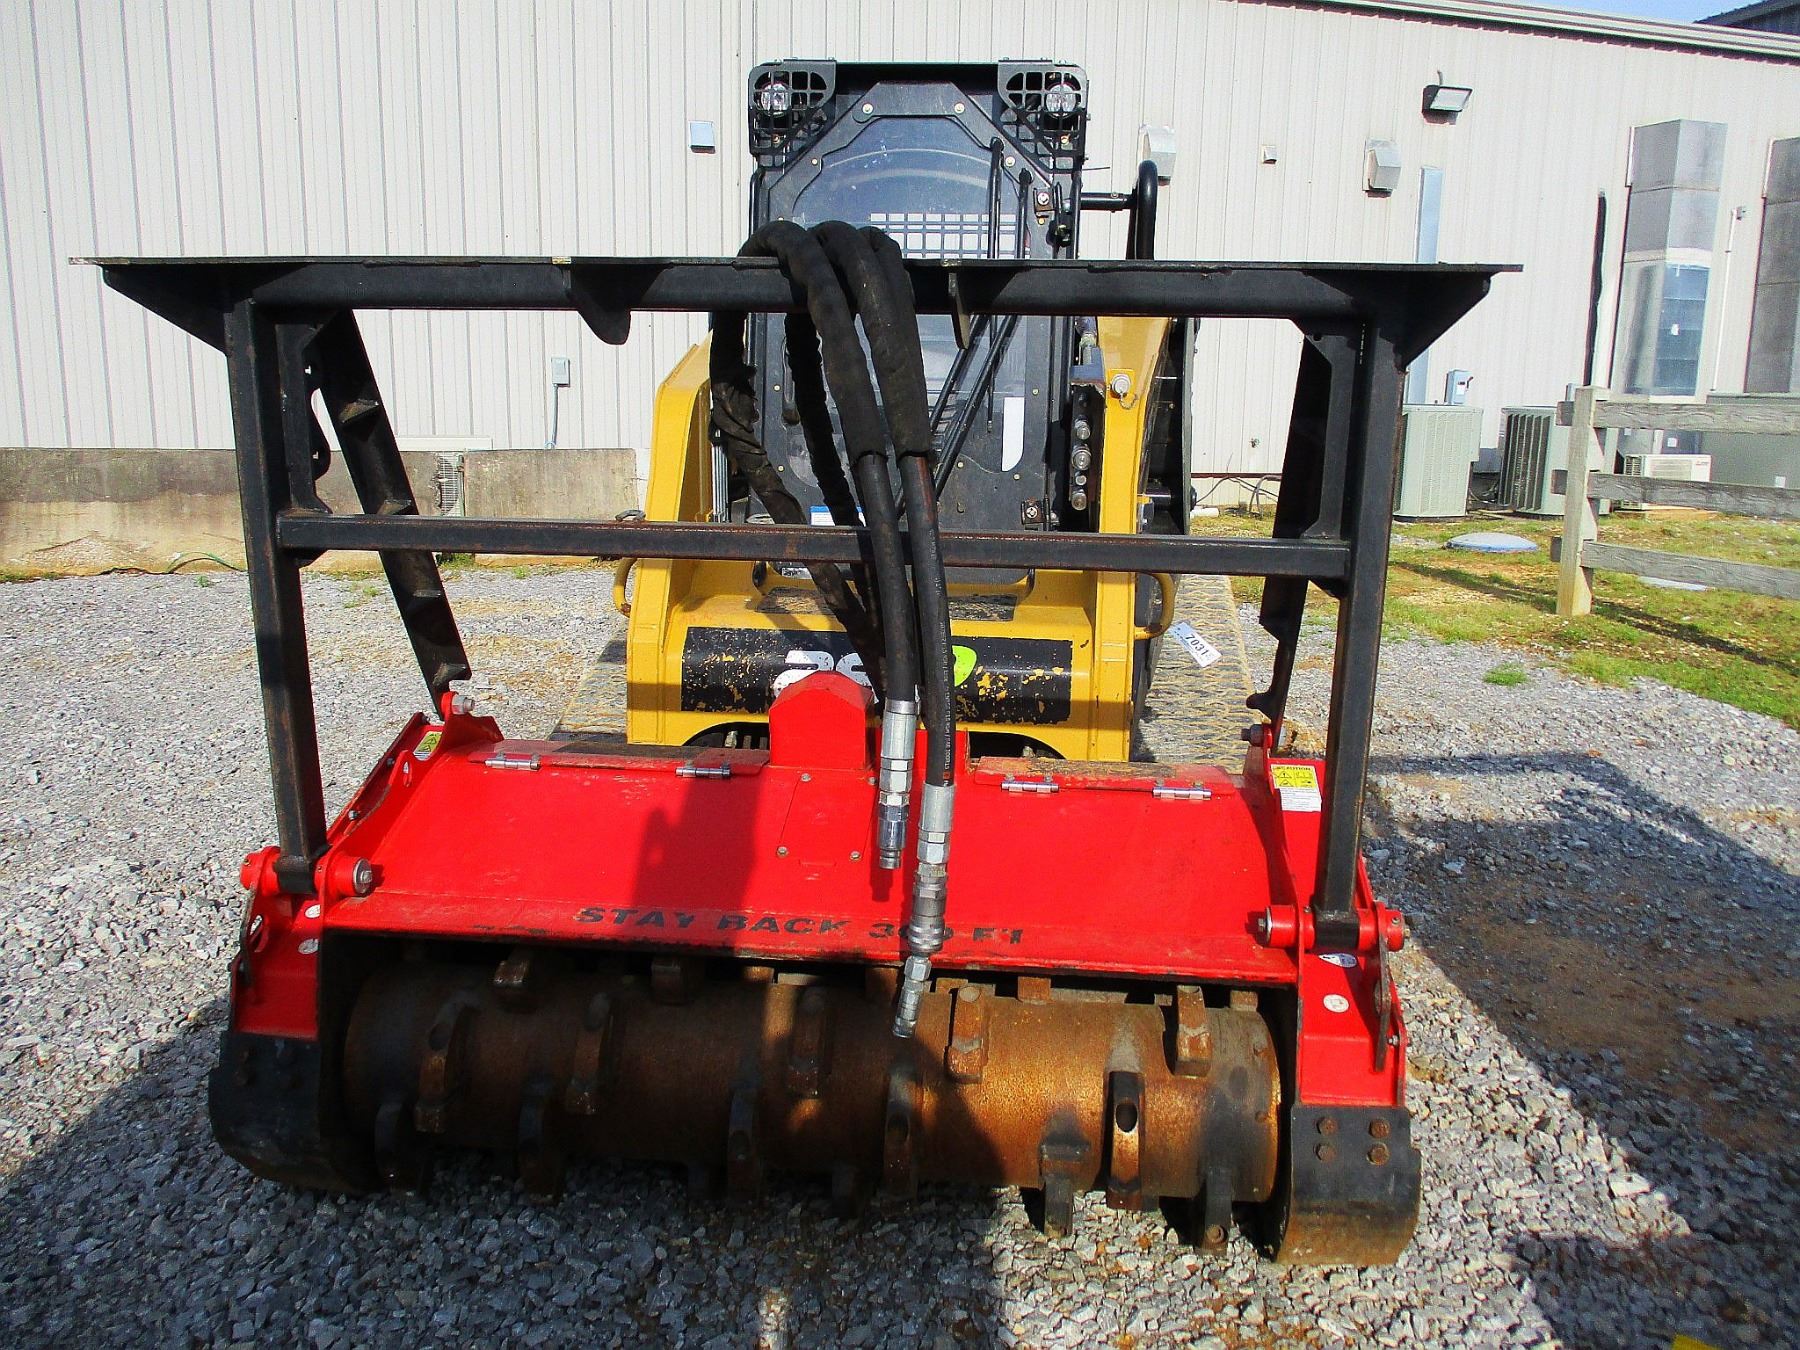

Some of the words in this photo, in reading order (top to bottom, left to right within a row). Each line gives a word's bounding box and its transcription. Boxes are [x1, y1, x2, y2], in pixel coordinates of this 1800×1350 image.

[1185, 633, 1209, 656] 7031
[574, 906, 695, 928] STAY
[717, 914, 852, 936] BACK
